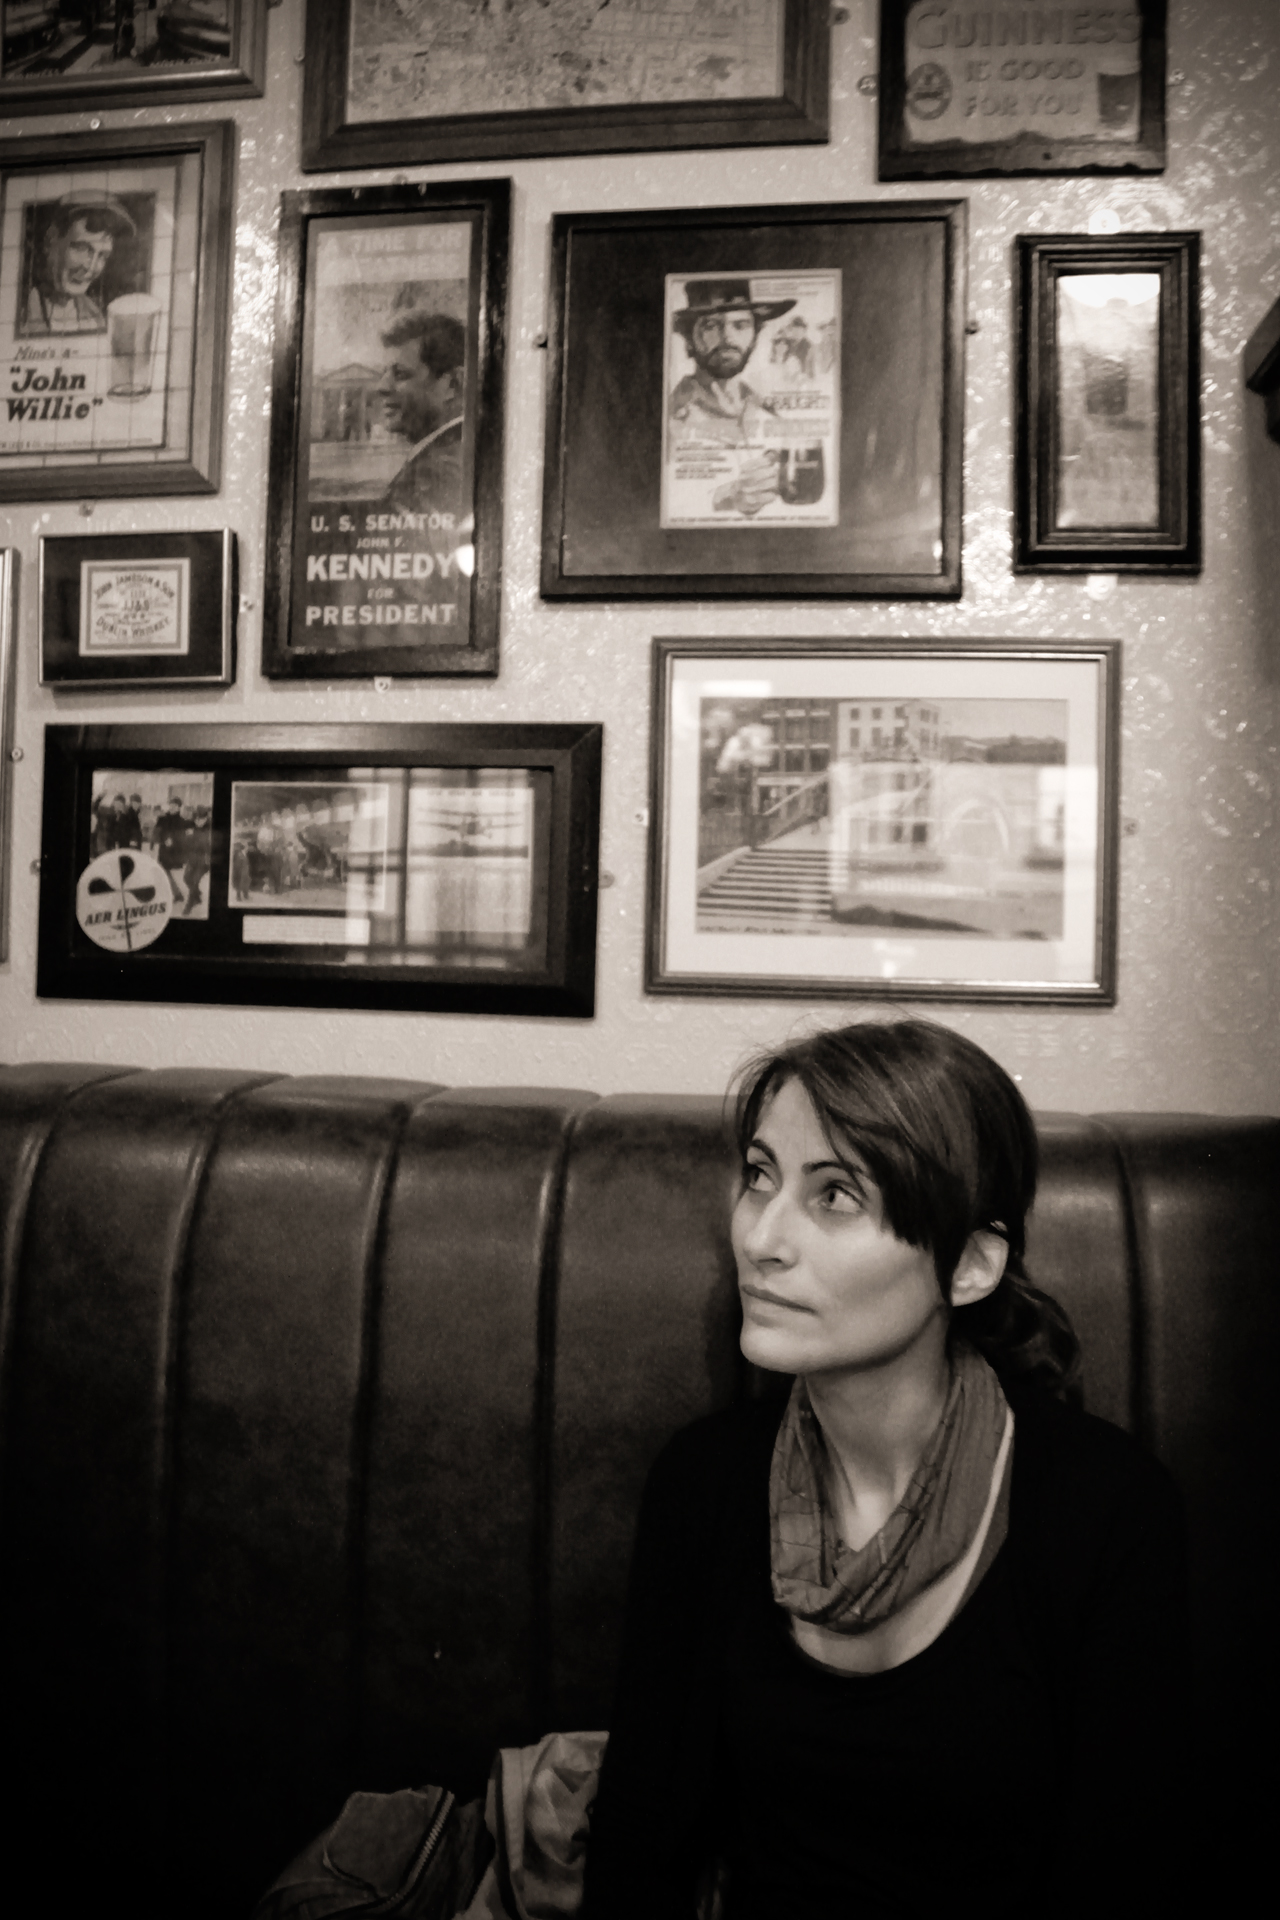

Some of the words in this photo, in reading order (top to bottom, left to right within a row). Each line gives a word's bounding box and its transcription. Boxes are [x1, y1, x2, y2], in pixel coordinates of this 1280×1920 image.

[915, 7, 1141, 50] GUINNESS
[1000, 56, 1086, 82] GOOD
[365, 511, 456, 532] SENATOR
[356, 536, 390, 549] JOHN
[306, 552, 457, 582] KENNEDY
[367, 587, 394, 600] FOR
[305, 603, 457, 627] PRESIDENT
[84, 911, 112, 927] AER
[117, 902, 167, 921] LINGUS
